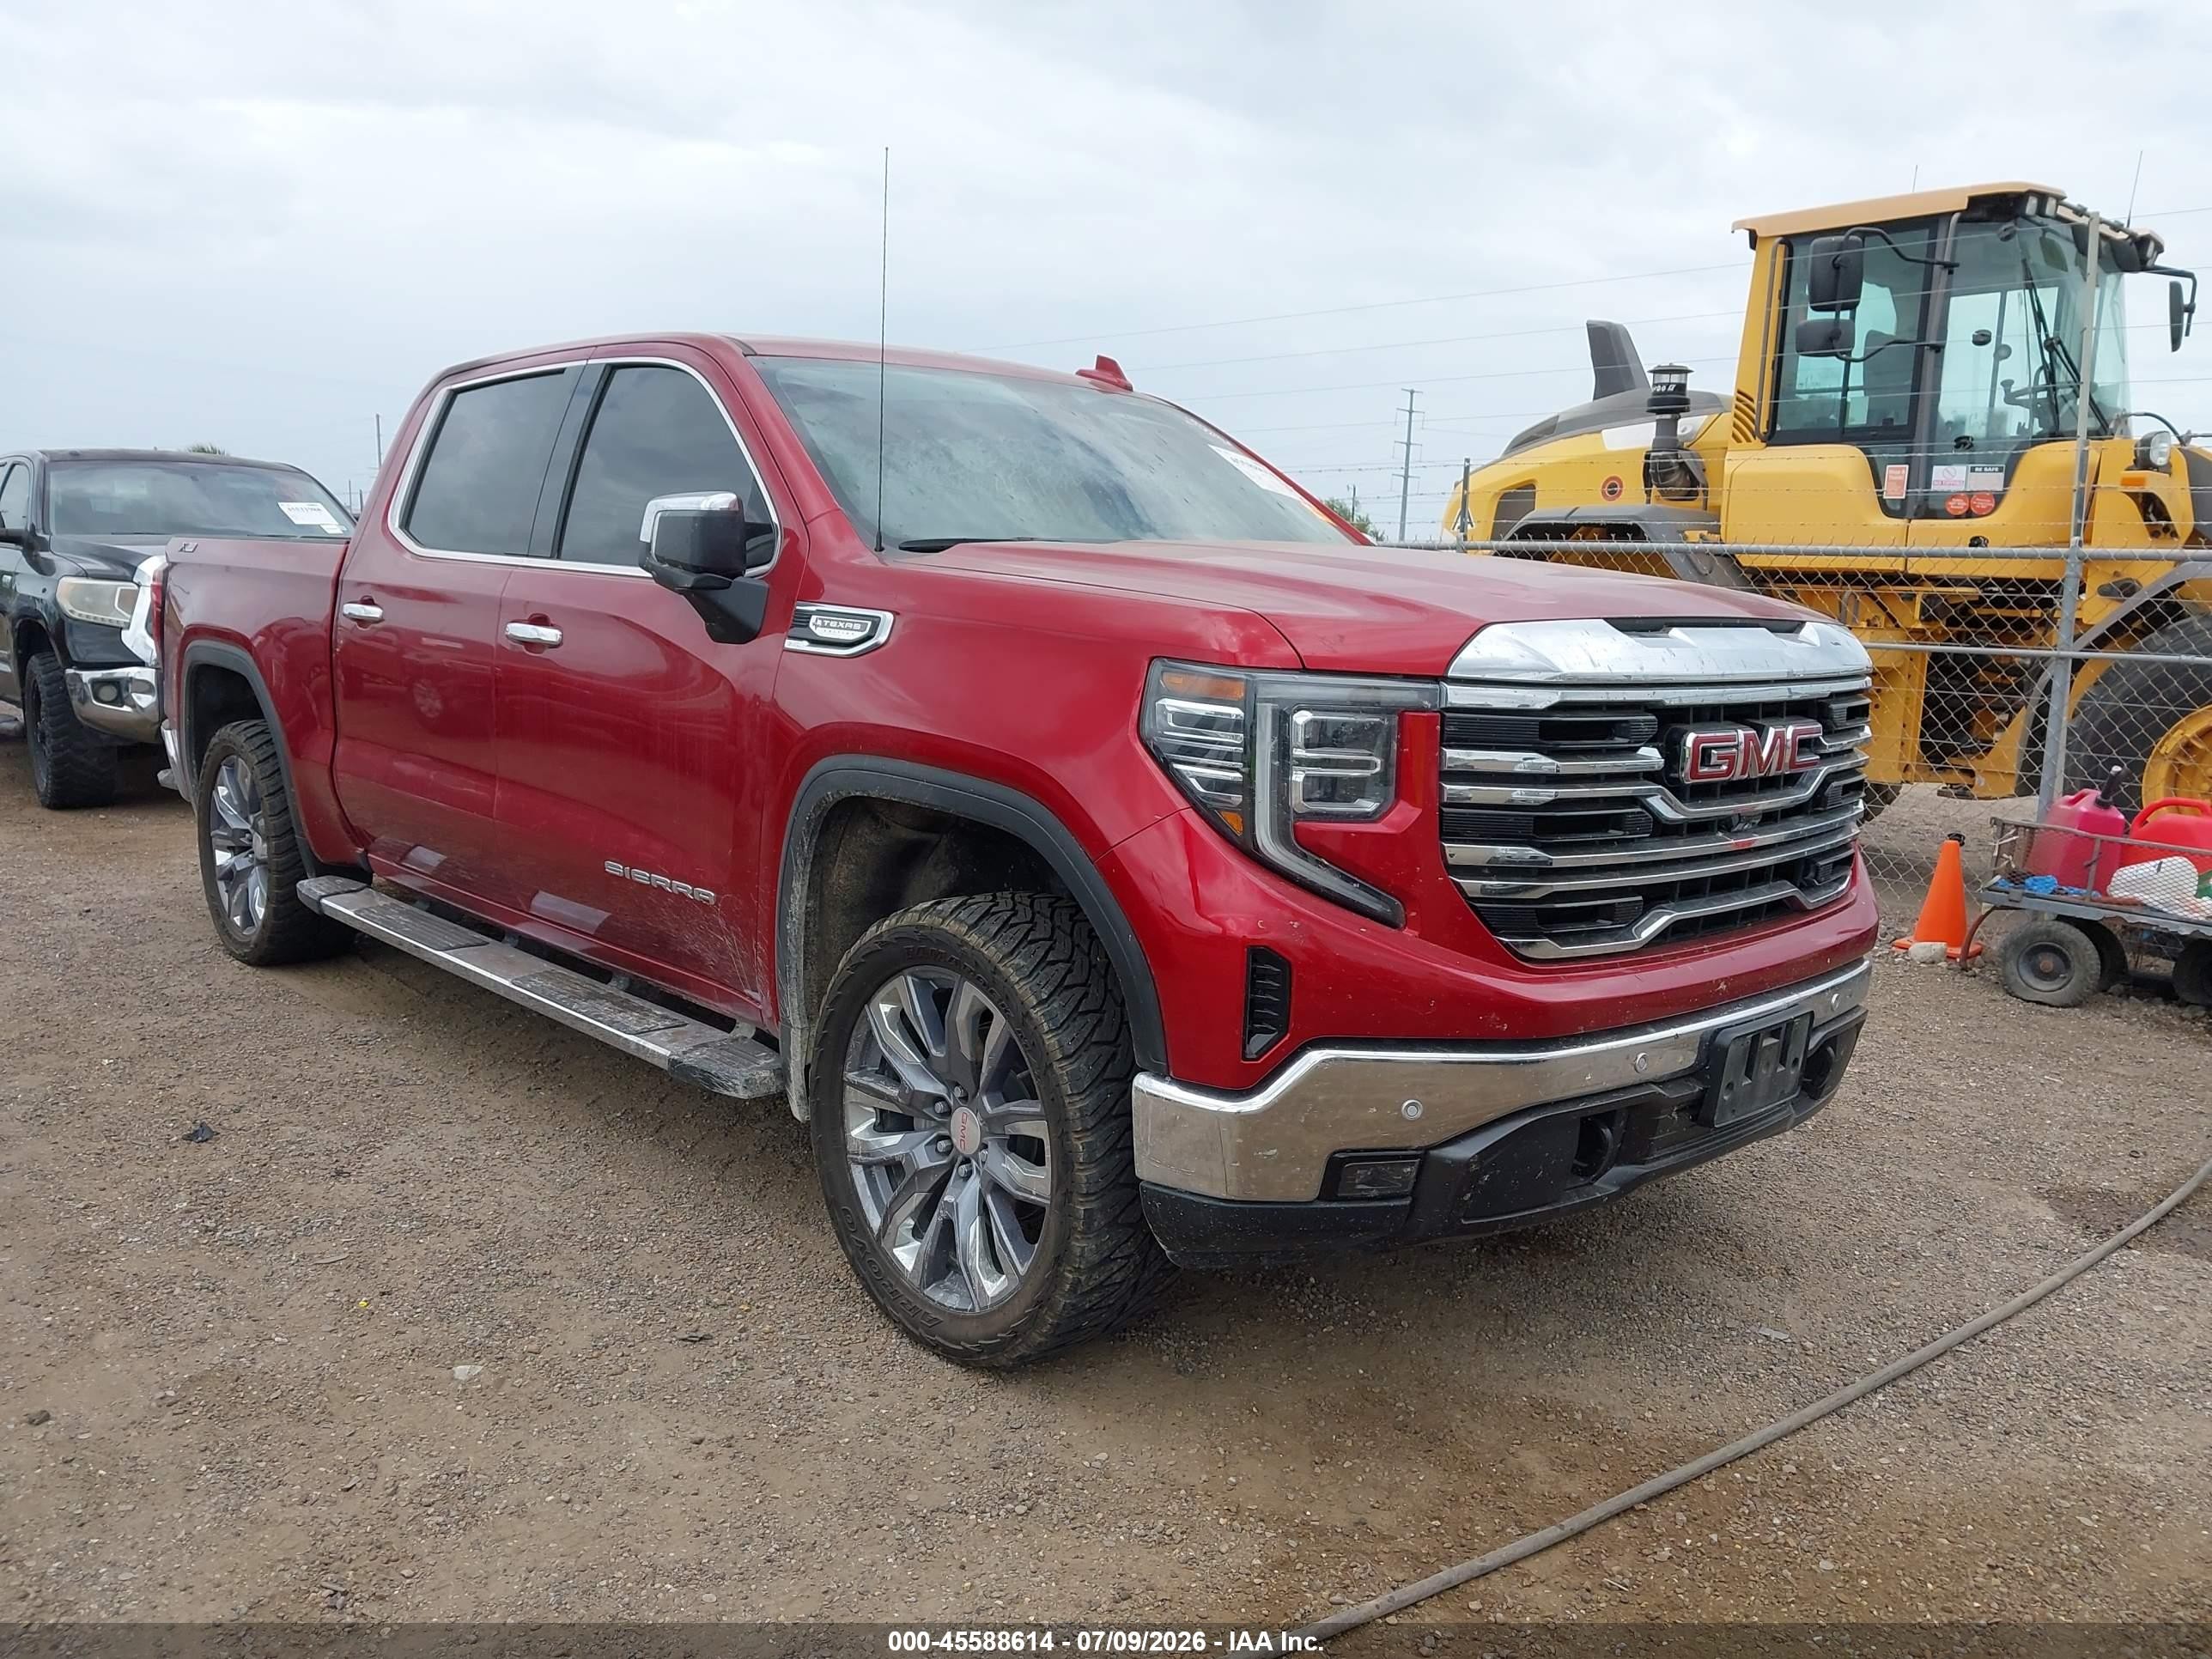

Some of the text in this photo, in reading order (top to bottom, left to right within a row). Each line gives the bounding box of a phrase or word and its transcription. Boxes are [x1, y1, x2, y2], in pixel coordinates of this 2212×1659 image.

[823, 619, 861, 630] TEXAS
[1683, 724, 1823, 783] GMC
[604, 860, 715, 905] SIERRA
[959, 1111, 969, 1152] GMC
[840, 1206, 944, 1329] ARROYO
